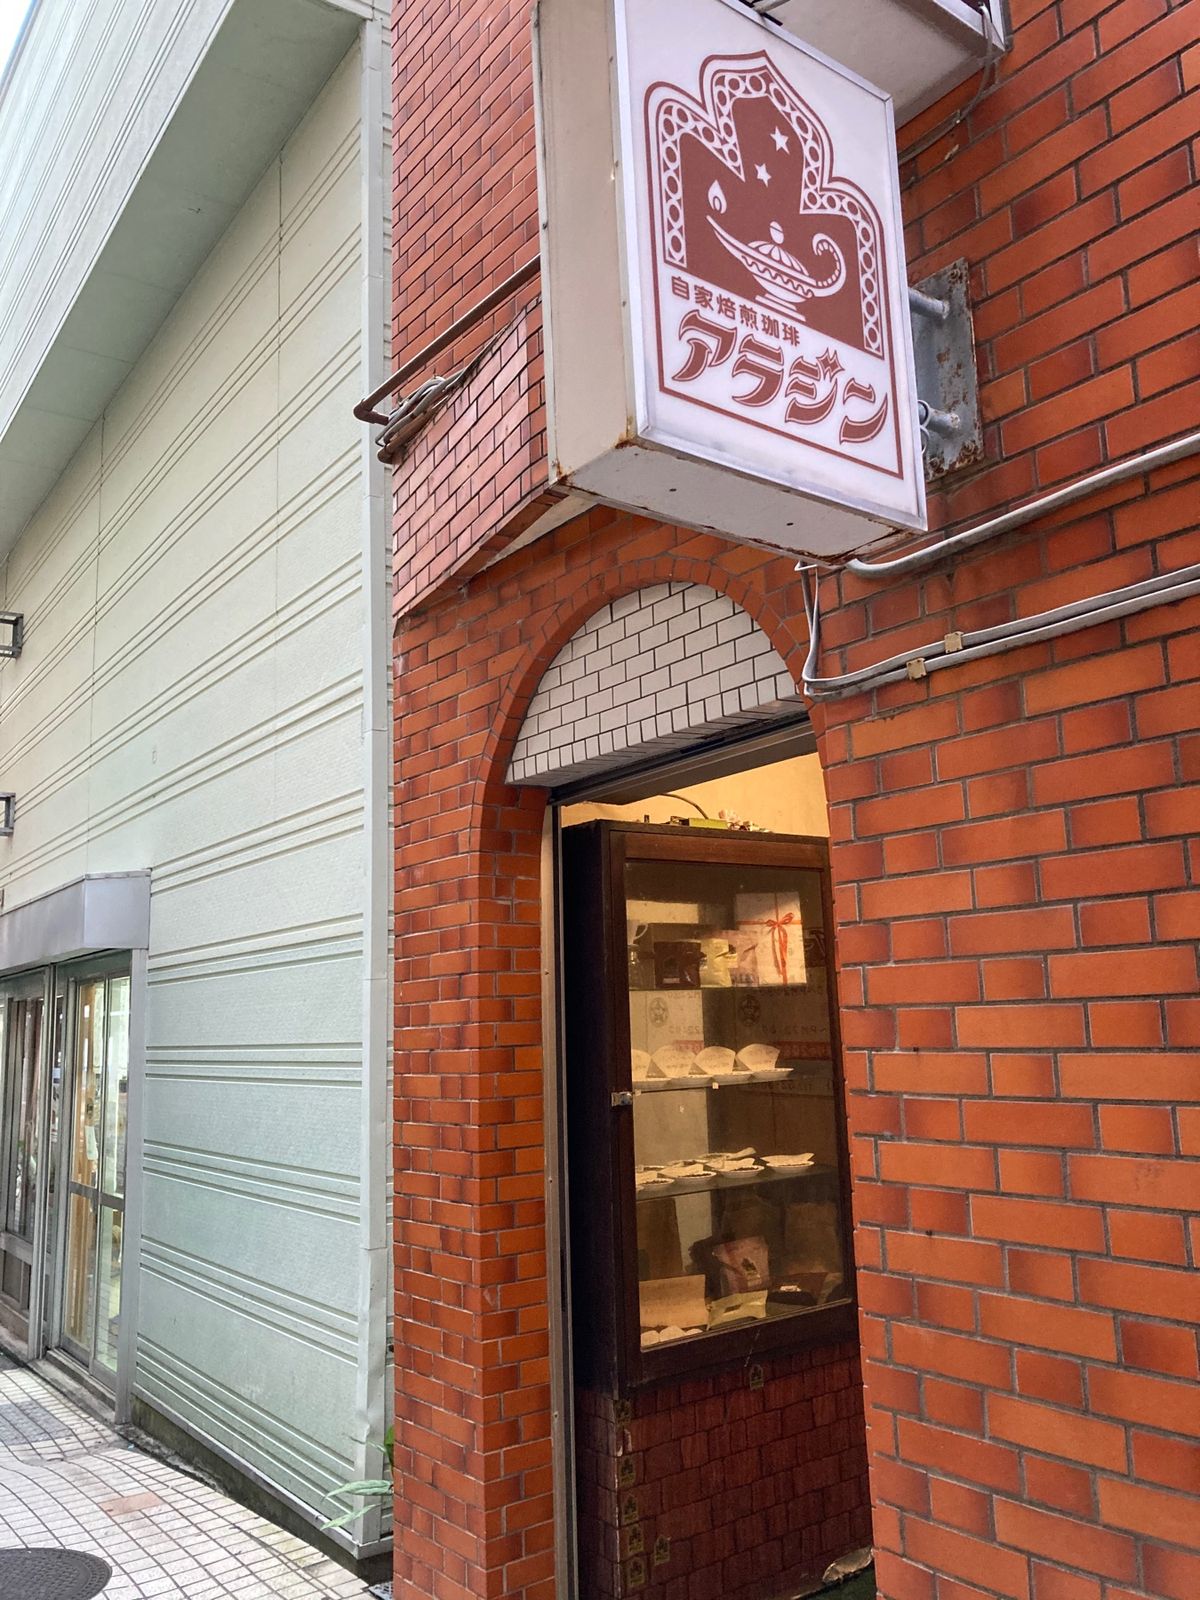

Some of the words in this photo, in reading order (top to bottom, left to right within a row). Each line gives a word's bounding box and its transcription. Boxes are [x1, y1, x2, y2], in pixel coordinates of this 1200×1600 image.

[671, 275, 800, 347] 自家焙煎珈琲
[671, 309, 888, 445] アラジン
